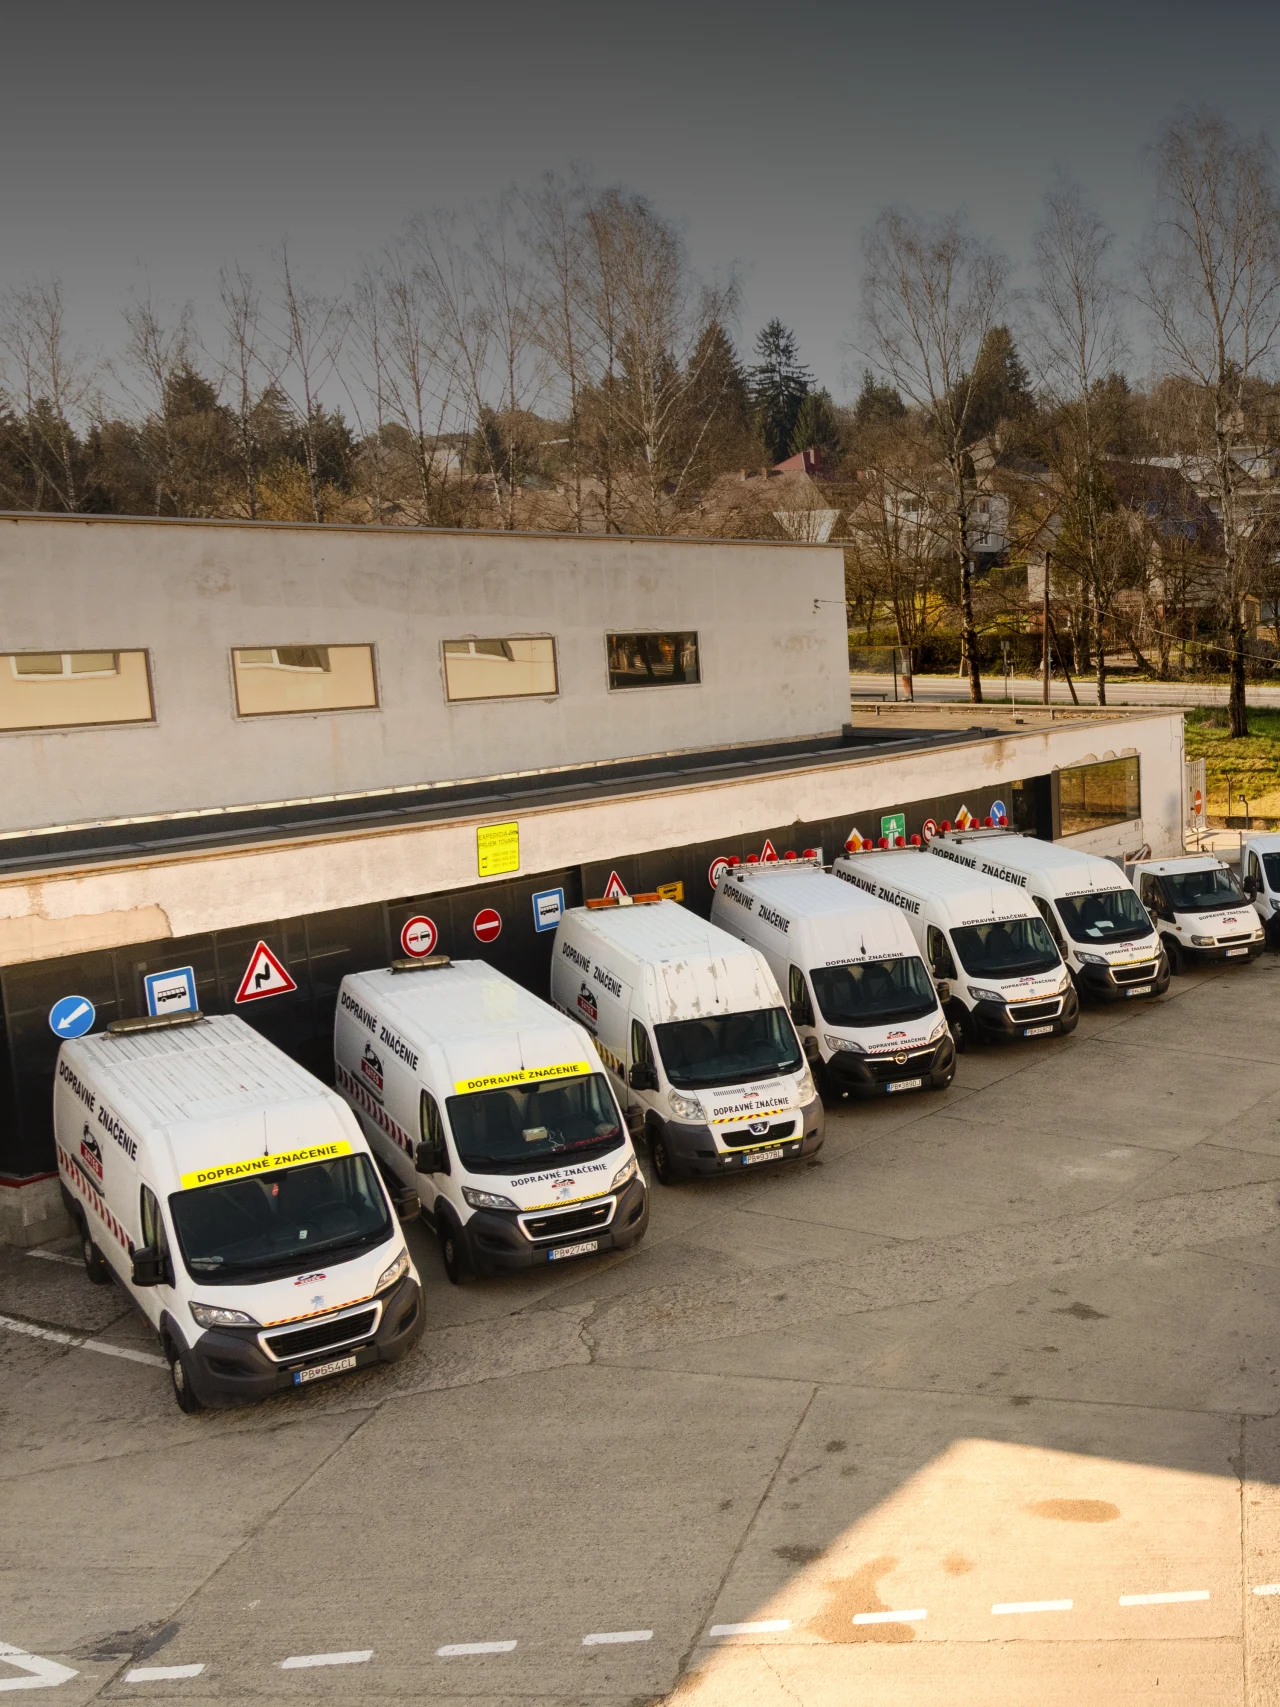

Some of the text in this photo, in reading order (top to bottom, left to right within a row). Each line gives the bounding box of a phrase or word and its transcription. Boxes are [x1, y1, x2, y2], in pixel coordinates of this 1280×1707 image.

[932, 847, 1027, 888] DOPRAVNÉ ZNAČENIE
[723, 883, 790, 933] DOPRAVNÉ ZNAČENIE
[836, 869, 921, 915] DOPRAVNÉ ZNAČENIE
[562, 942, 622, 998] DOPRAVNÉ ZNAČENIE
[341, 991, 419, 1071] DOPRAVNÉ ZNAČENIE
[364, 1064, 380, 1085] SATES
[468, 1065, 580, 1089] DOPRAVNÉ ZNAČENIE
[59, 1060, 138, 1161] DOPRAVNÉ ZNAČENIE
[713, 1097, 789, 1116] DOPRAVNÉ ZNAČENIE
[197, 1145, 338, 1183] DOPRAVNÉ ZNAČENIE
[510, 1163, 608, 1187] DOPRAVNÉ ZNAČENIE
